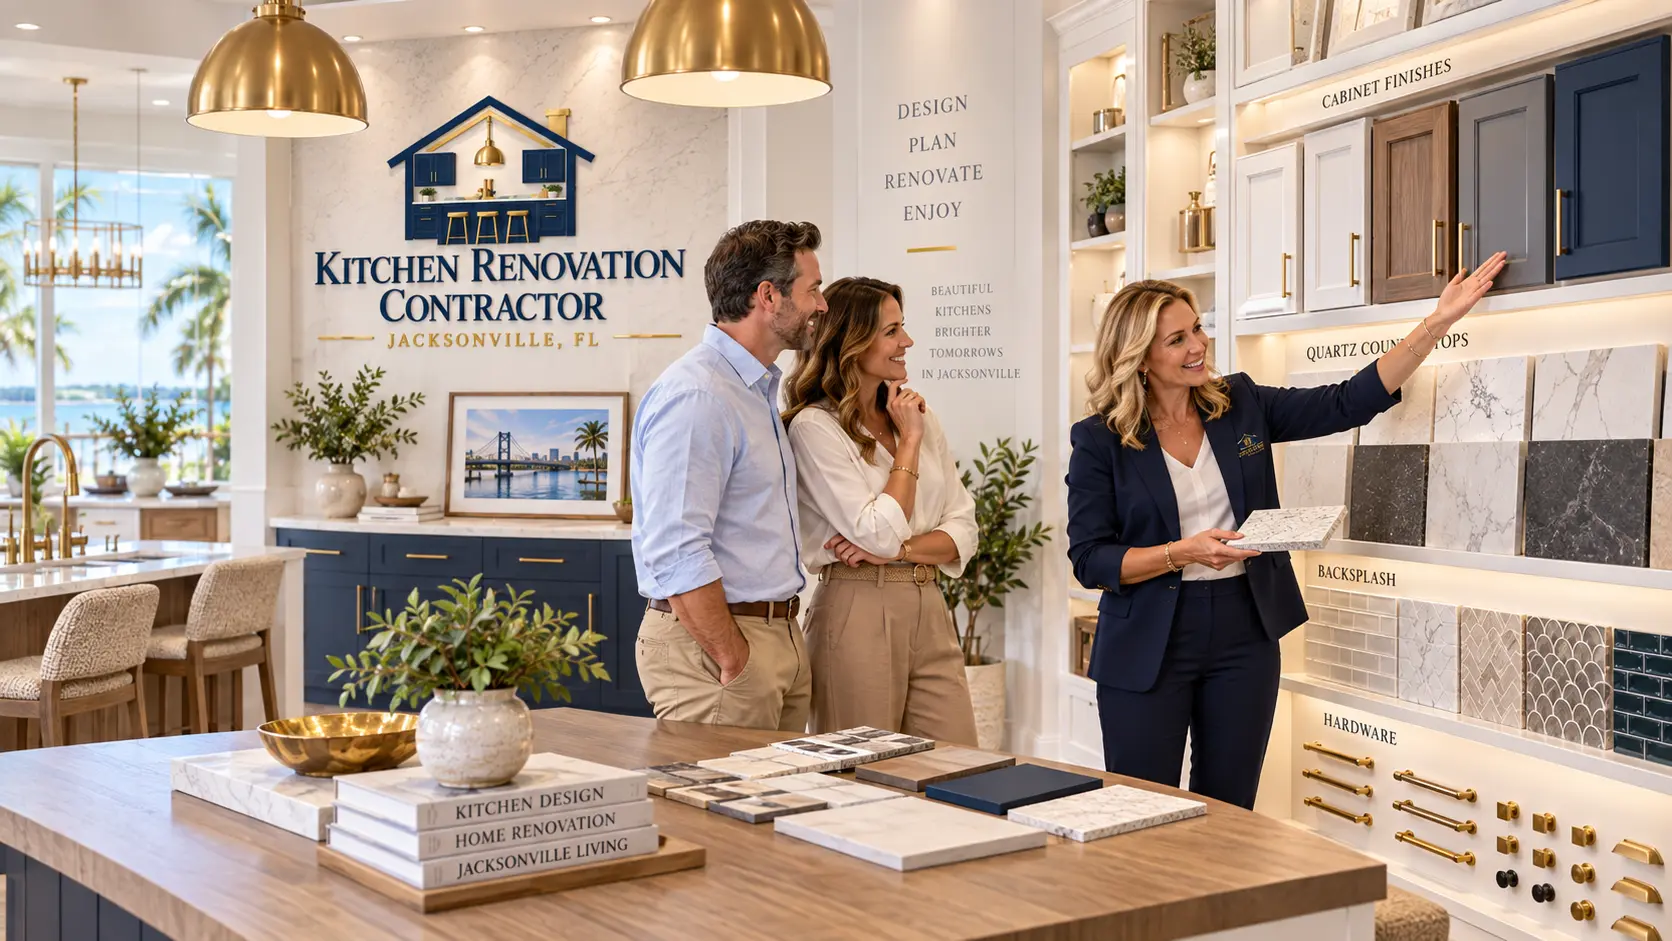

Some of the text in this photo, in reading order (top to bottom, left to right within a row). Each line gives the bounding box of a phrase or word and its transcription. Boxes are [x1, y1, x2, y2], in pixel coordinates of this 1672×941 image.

[1322, 58, 1452, 109] CABINET FINISHES
[897, 94, 968, 120] DESIGN
[909, 132, 957, 153] PLAN
[885, 164, 983, 190] RENOVATE
[903, 201, 962, 222] ENJOY
[931, 283, 994, 296] BEAUTIFUL
[935, 304, 992, 317] KITCHENS
[387, 332, 600, 350] JACKSONVILLE, FL
[935, 325, 991, 338] BRIGHTER
[929, 347, 1004, 359] TOMORROWS
[1306, 343, 1357, 362] QUARTZ
[921, 368, 1021, 381] IN JACKSONVILLE
[1318, 564, 1396, 587] BACKSPLASH
[1323, 712, 1398, 746] HARDWARE
[455, 786, 605, 820] KITCHEN DESIGN
[455, 812, 617, 849] HOME RENOVATION
[456, 838, 629, 880] JACKSONVILLE LIVING
